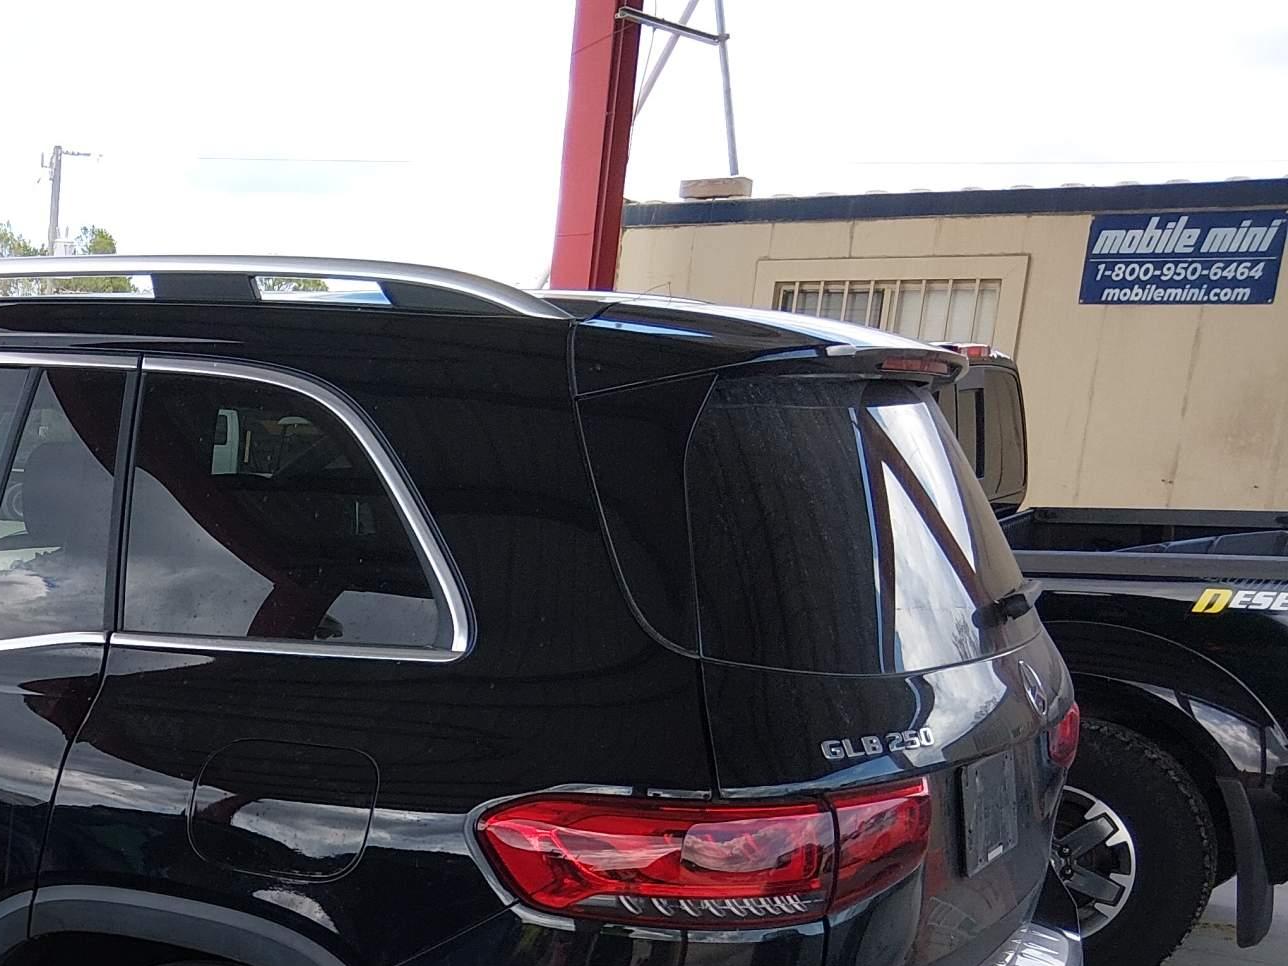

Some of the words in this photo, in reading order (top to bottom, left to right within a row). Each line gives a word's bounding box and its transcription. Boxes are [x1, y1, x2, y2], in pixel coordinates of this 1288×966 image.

[1092, 216, 1201, 255] mobile
[1200, 219, 1283, 252] mini
[1095, 262, 1265, 282] 1-800-950-6464
[1101, 284, 1251, 302] mobilemini.com
[821, 736, 883, 760] GLB
[885, 727, 934, 752] 250
